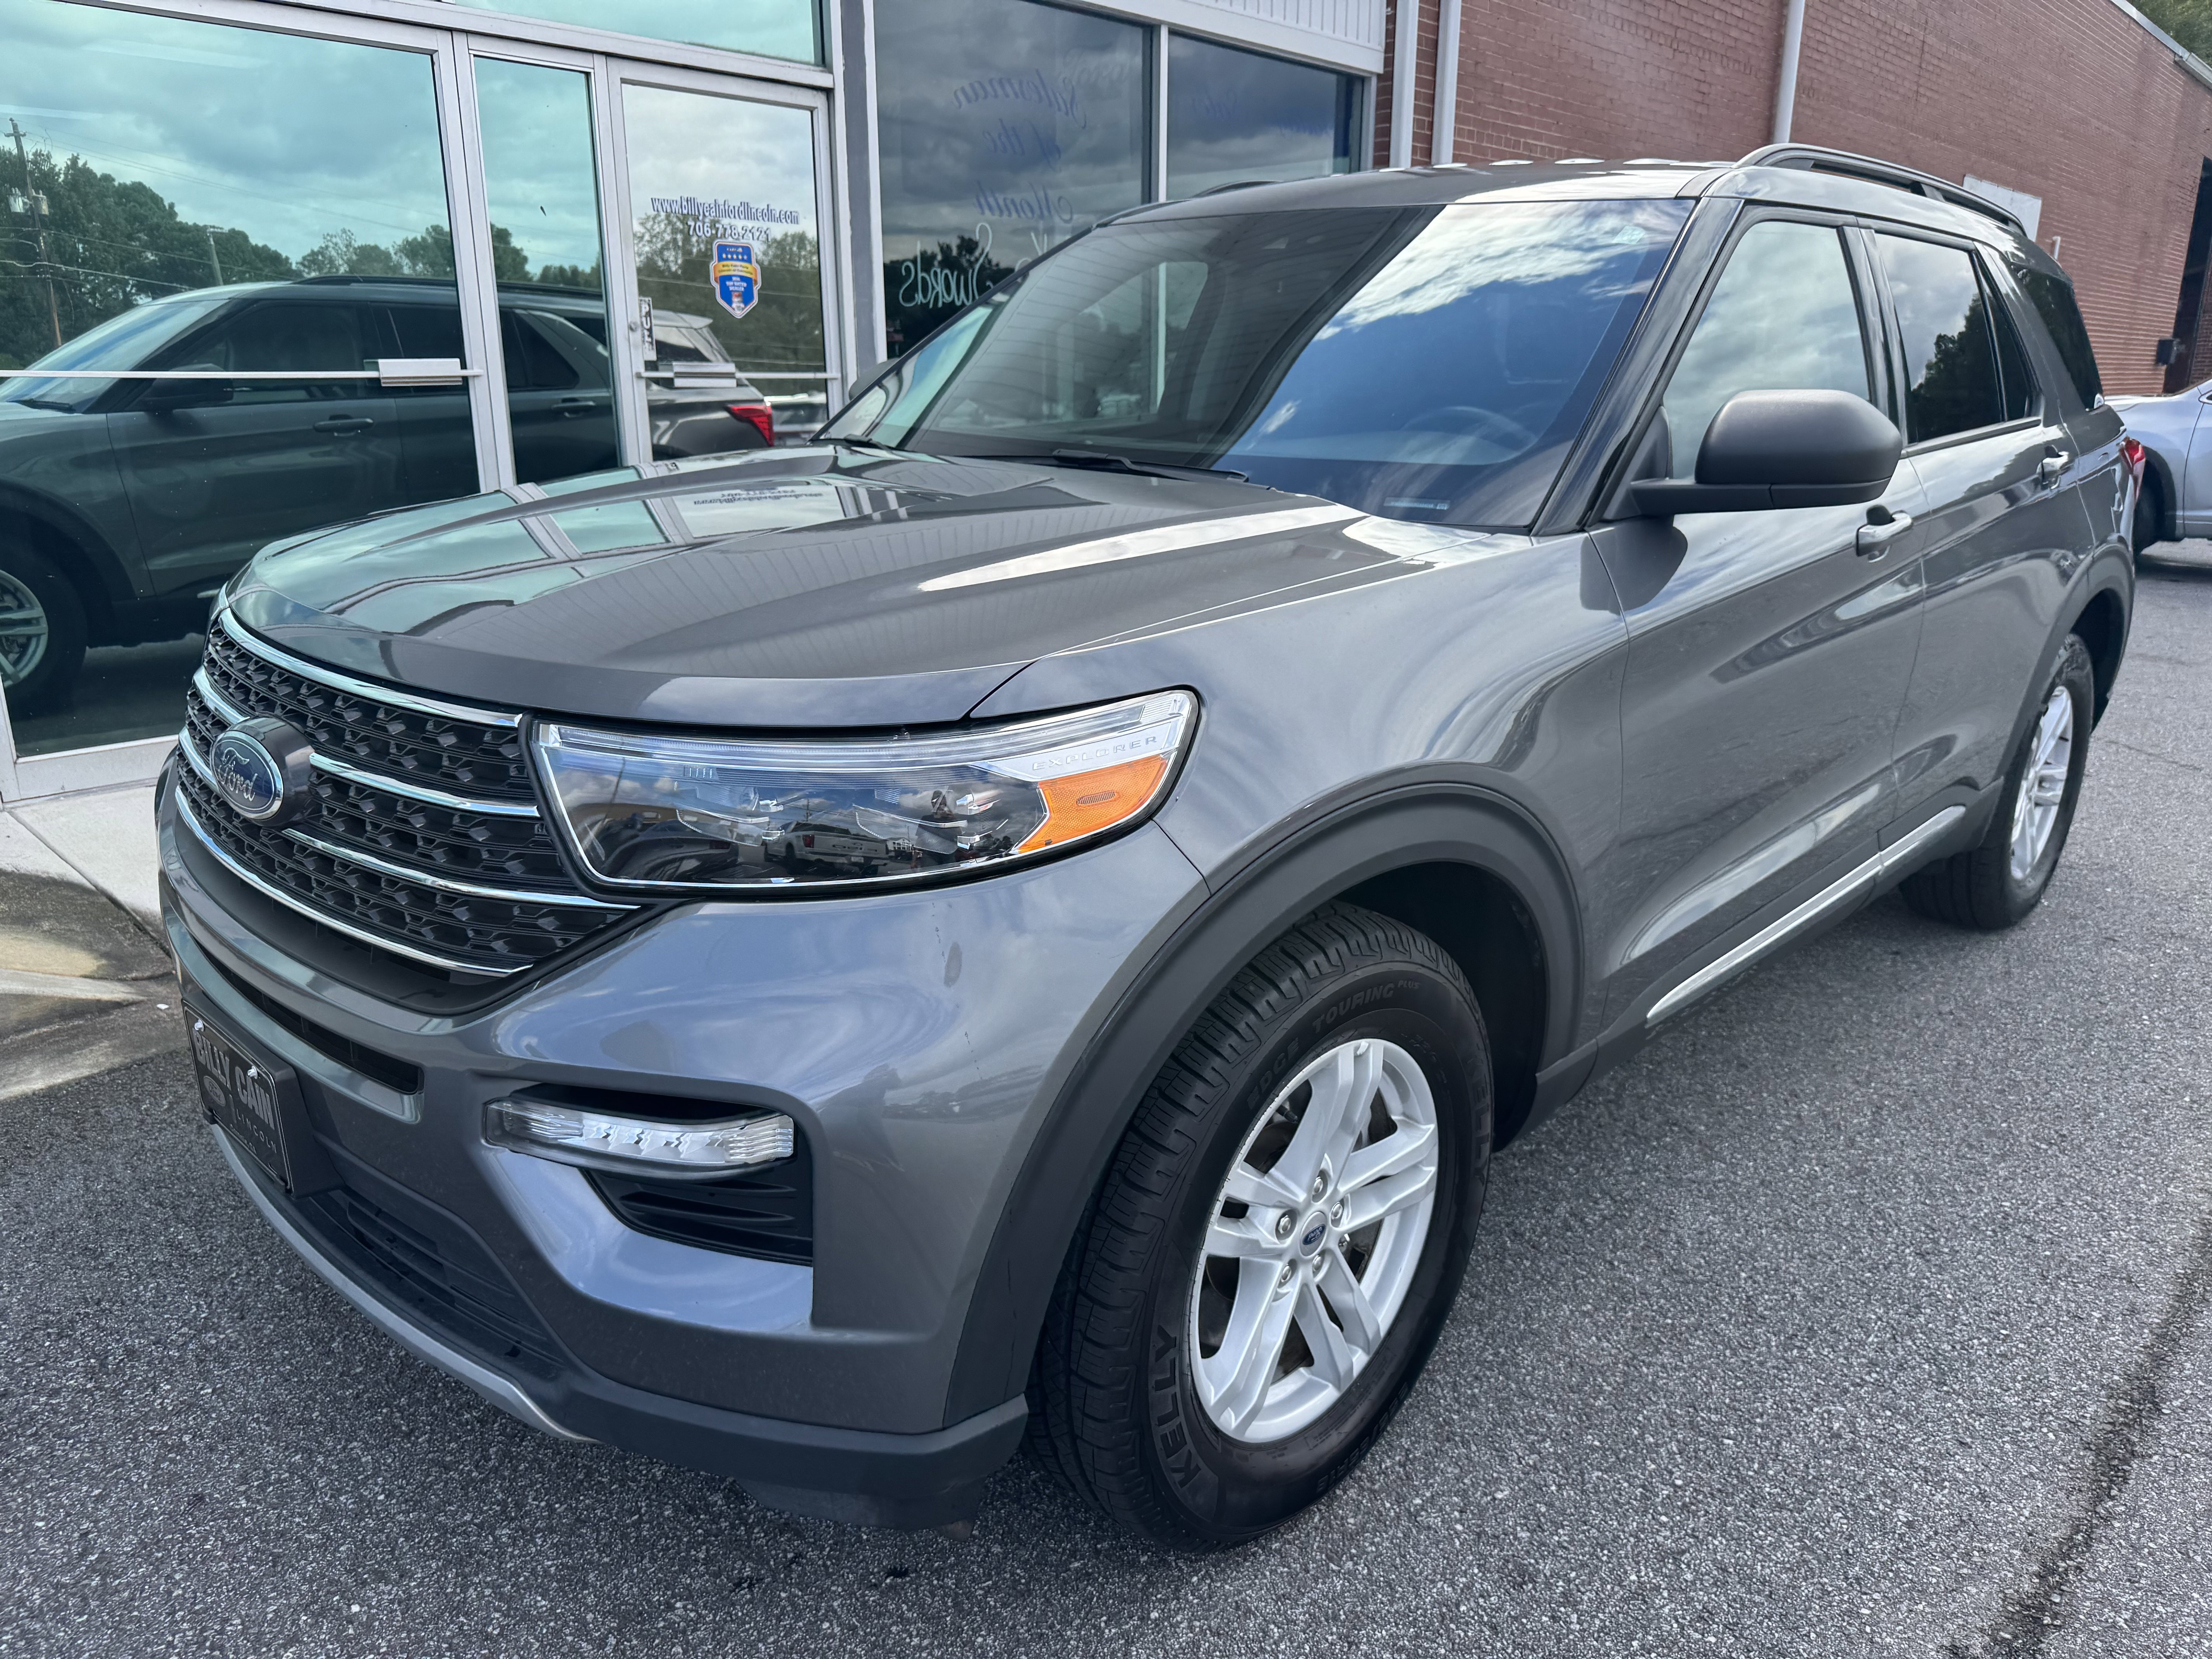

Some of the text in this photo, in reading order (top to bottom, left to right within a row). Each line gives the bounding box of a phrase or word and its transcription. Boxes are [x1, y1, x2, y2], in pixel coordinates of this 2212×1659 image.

[217, 747, 258, 802] Ford
[1032, 736, 1157, 771] EXPLORER
[1312, 980, 1422, 1034] TOURING PLUS
[192, 1027, 275, 1130] BILLY CAIN
[1246, 1036, 1300, 1110] EDGE
[236, 1109, 277, 1154] LINCOLN
[1154, 1324, 1201, 1489] KELLY
